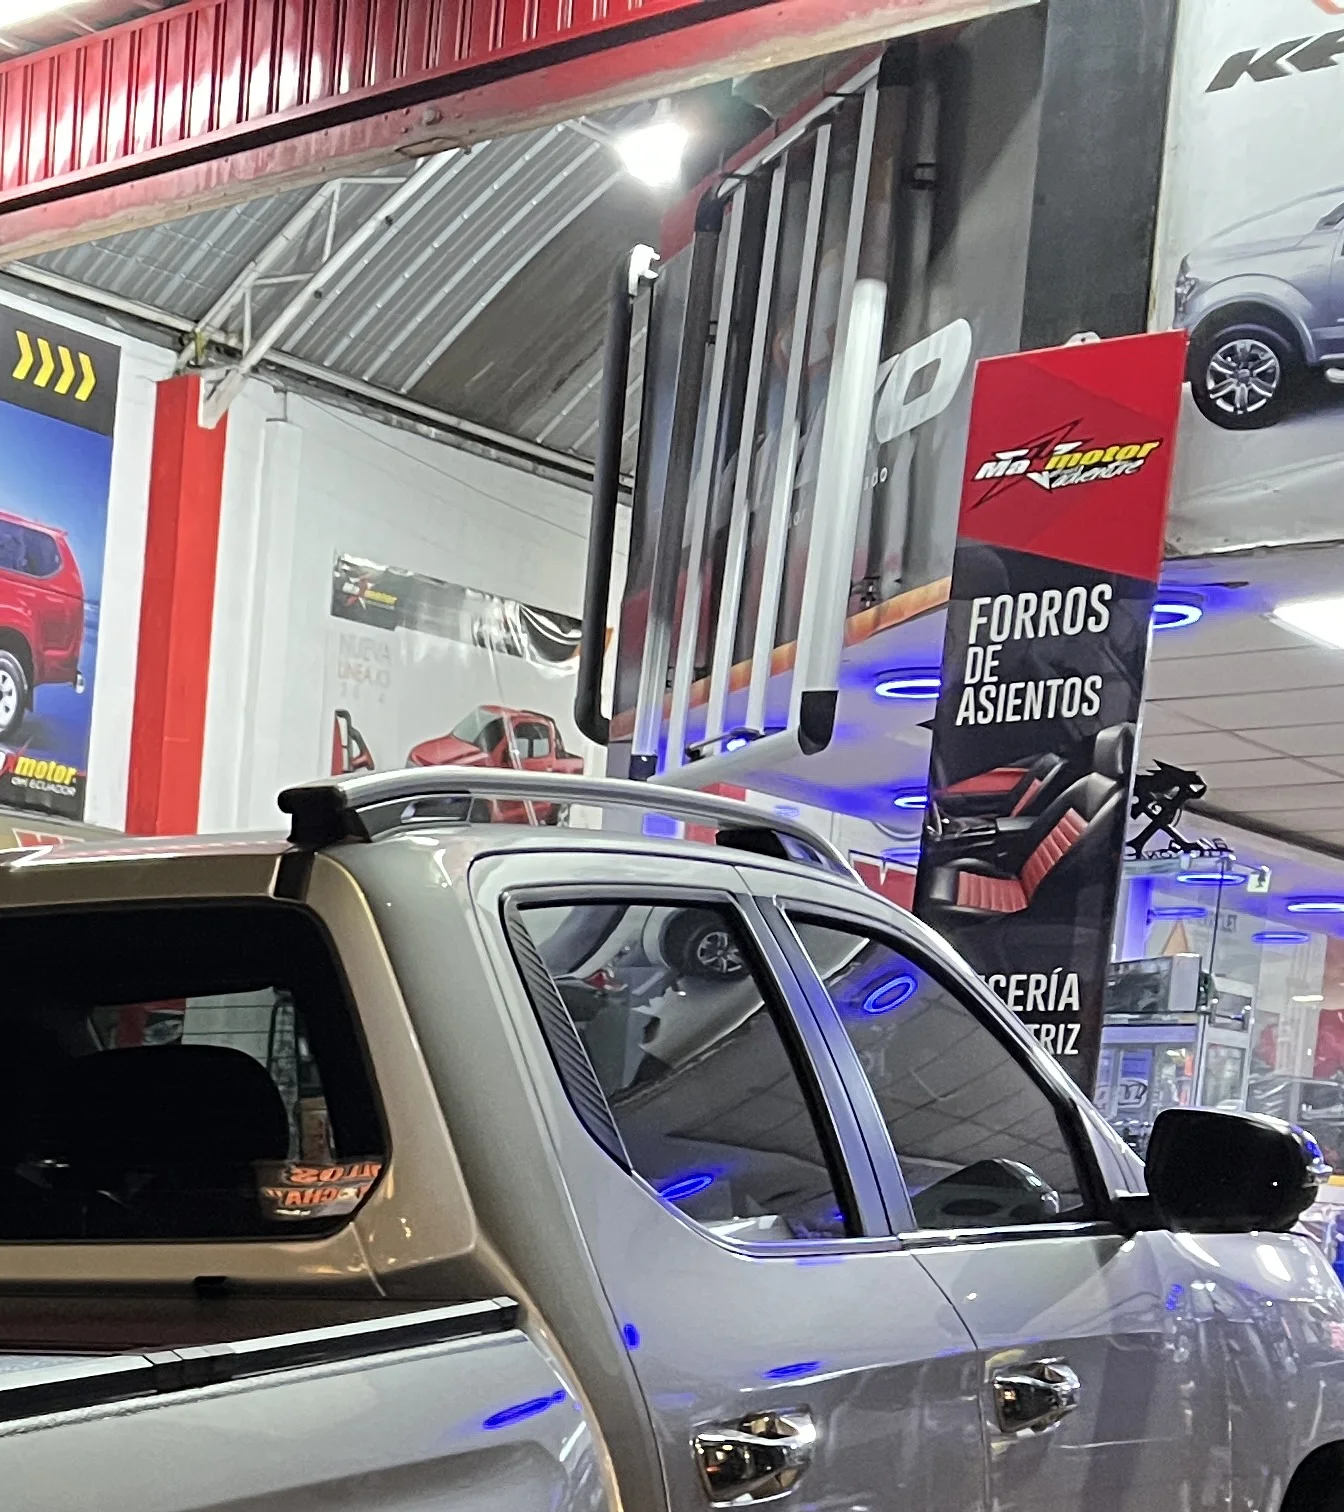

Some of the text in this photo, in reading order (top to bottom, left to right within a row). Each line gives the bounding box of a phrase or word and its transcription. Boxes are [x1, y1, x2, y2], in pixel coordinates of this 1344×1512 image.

[968, 583, 1113, 645] FORROS
[964, 644, 1003, 685] DE
[955, 674, 1103, 726] ASIENTOS
